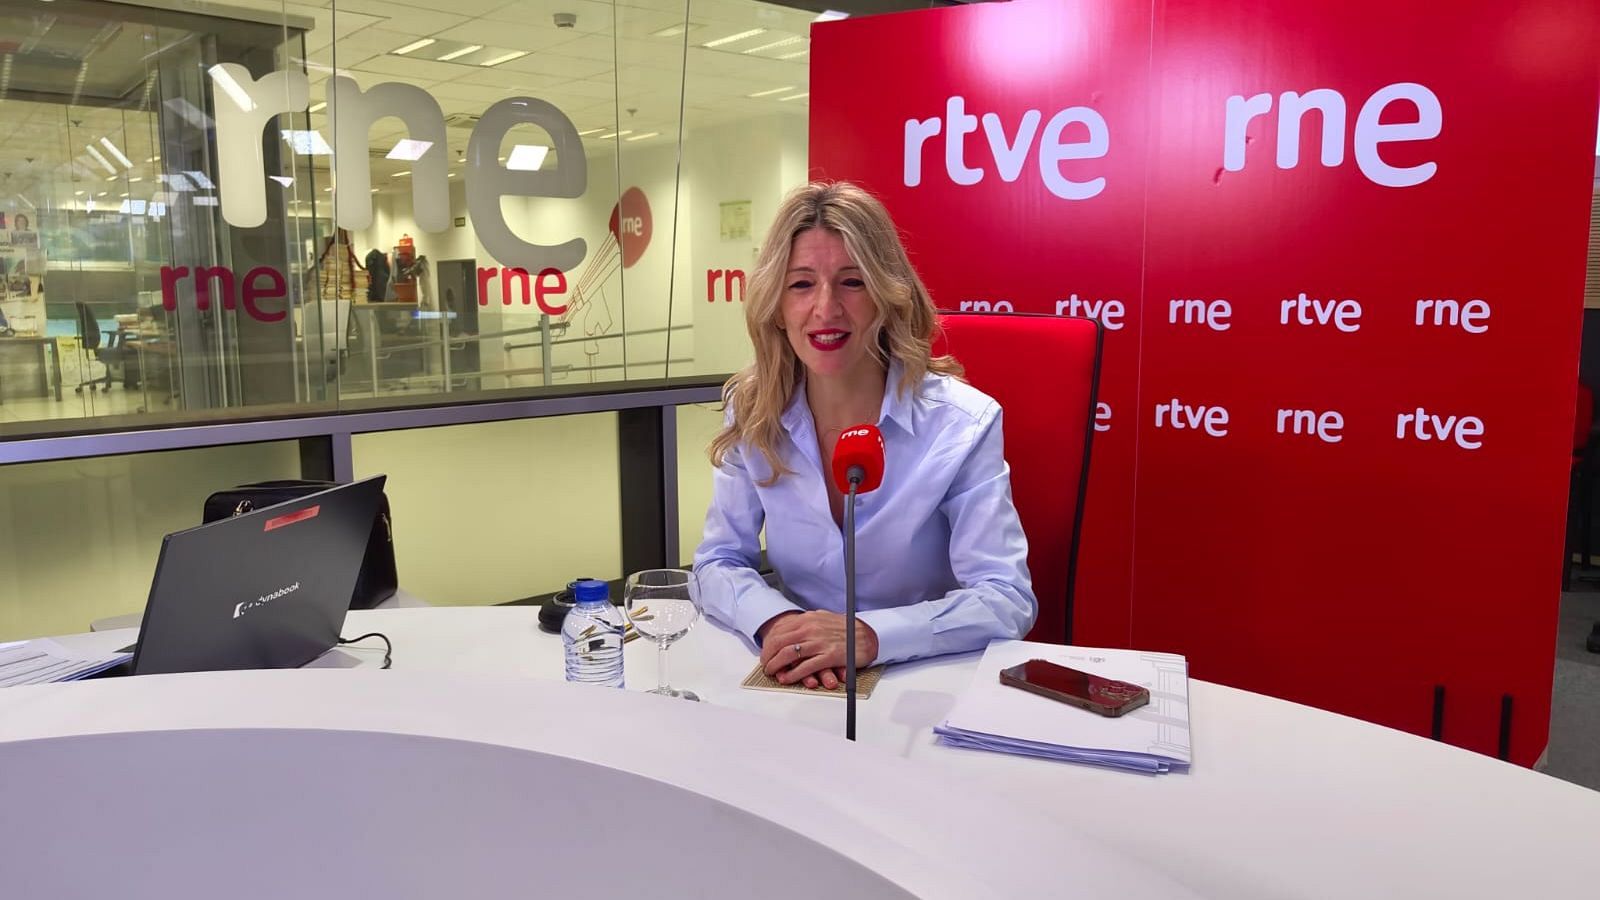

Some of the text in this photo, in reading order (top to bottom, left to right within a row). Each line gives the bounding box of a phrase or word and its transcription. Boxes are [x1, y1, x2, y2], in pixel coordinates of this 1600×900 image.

[904, 95, 1110, 200] rtve
[1224, 82, 1443, 188] rne
[208, 62, 588, 274] rne
[622, 217, 643, 237] rne
[160, 266, 287, 322] rne
[477, 266, 568, 315] rne
[706, 268, 746, 302] rn
[1055, 294, 1125, 330] rtve
[1169, 299, 1232, 331] rne
[1280, 293, 1362, 332] rtve
[1415, 299, 1491, 334] rne
[841, 429, 869, 440] rne
[1155, 398, 1229, 437] rtve
[1277, 409, 1344, 443] rne
[1396, 407, 1484, 450] rtve
[255, 581, 300, 606] dynabook
